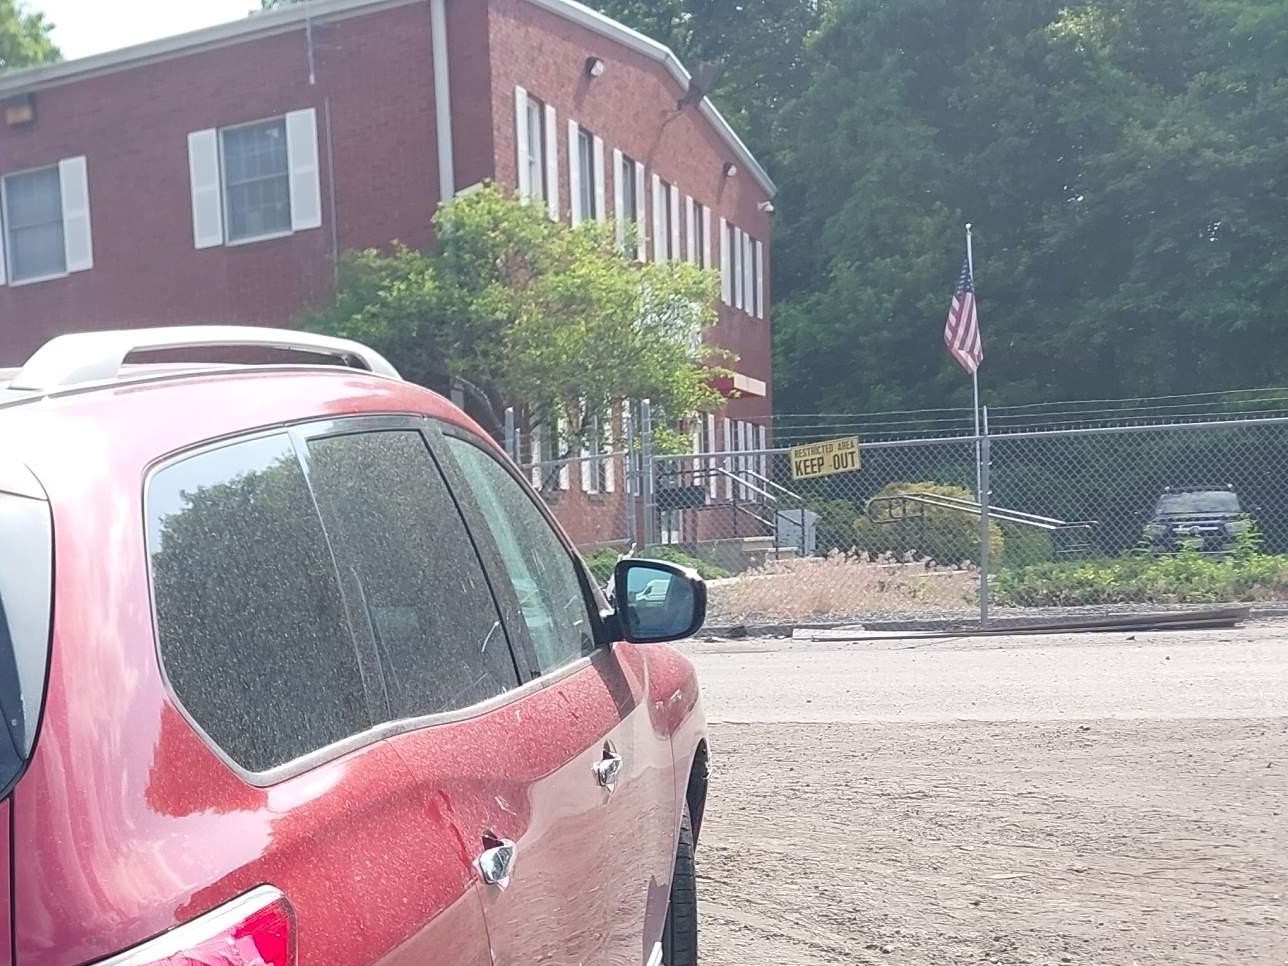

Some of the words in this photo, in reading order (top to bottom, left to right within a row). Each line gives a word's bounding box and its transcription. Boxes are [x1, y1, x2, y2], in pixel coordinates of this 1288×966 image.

[794, 444, 834, 458] RESTRICTED
[837, 440, 855, 451] AREA
[795, 456, 825, 476] KEEP
[833, 451, 856, 470] OUT
